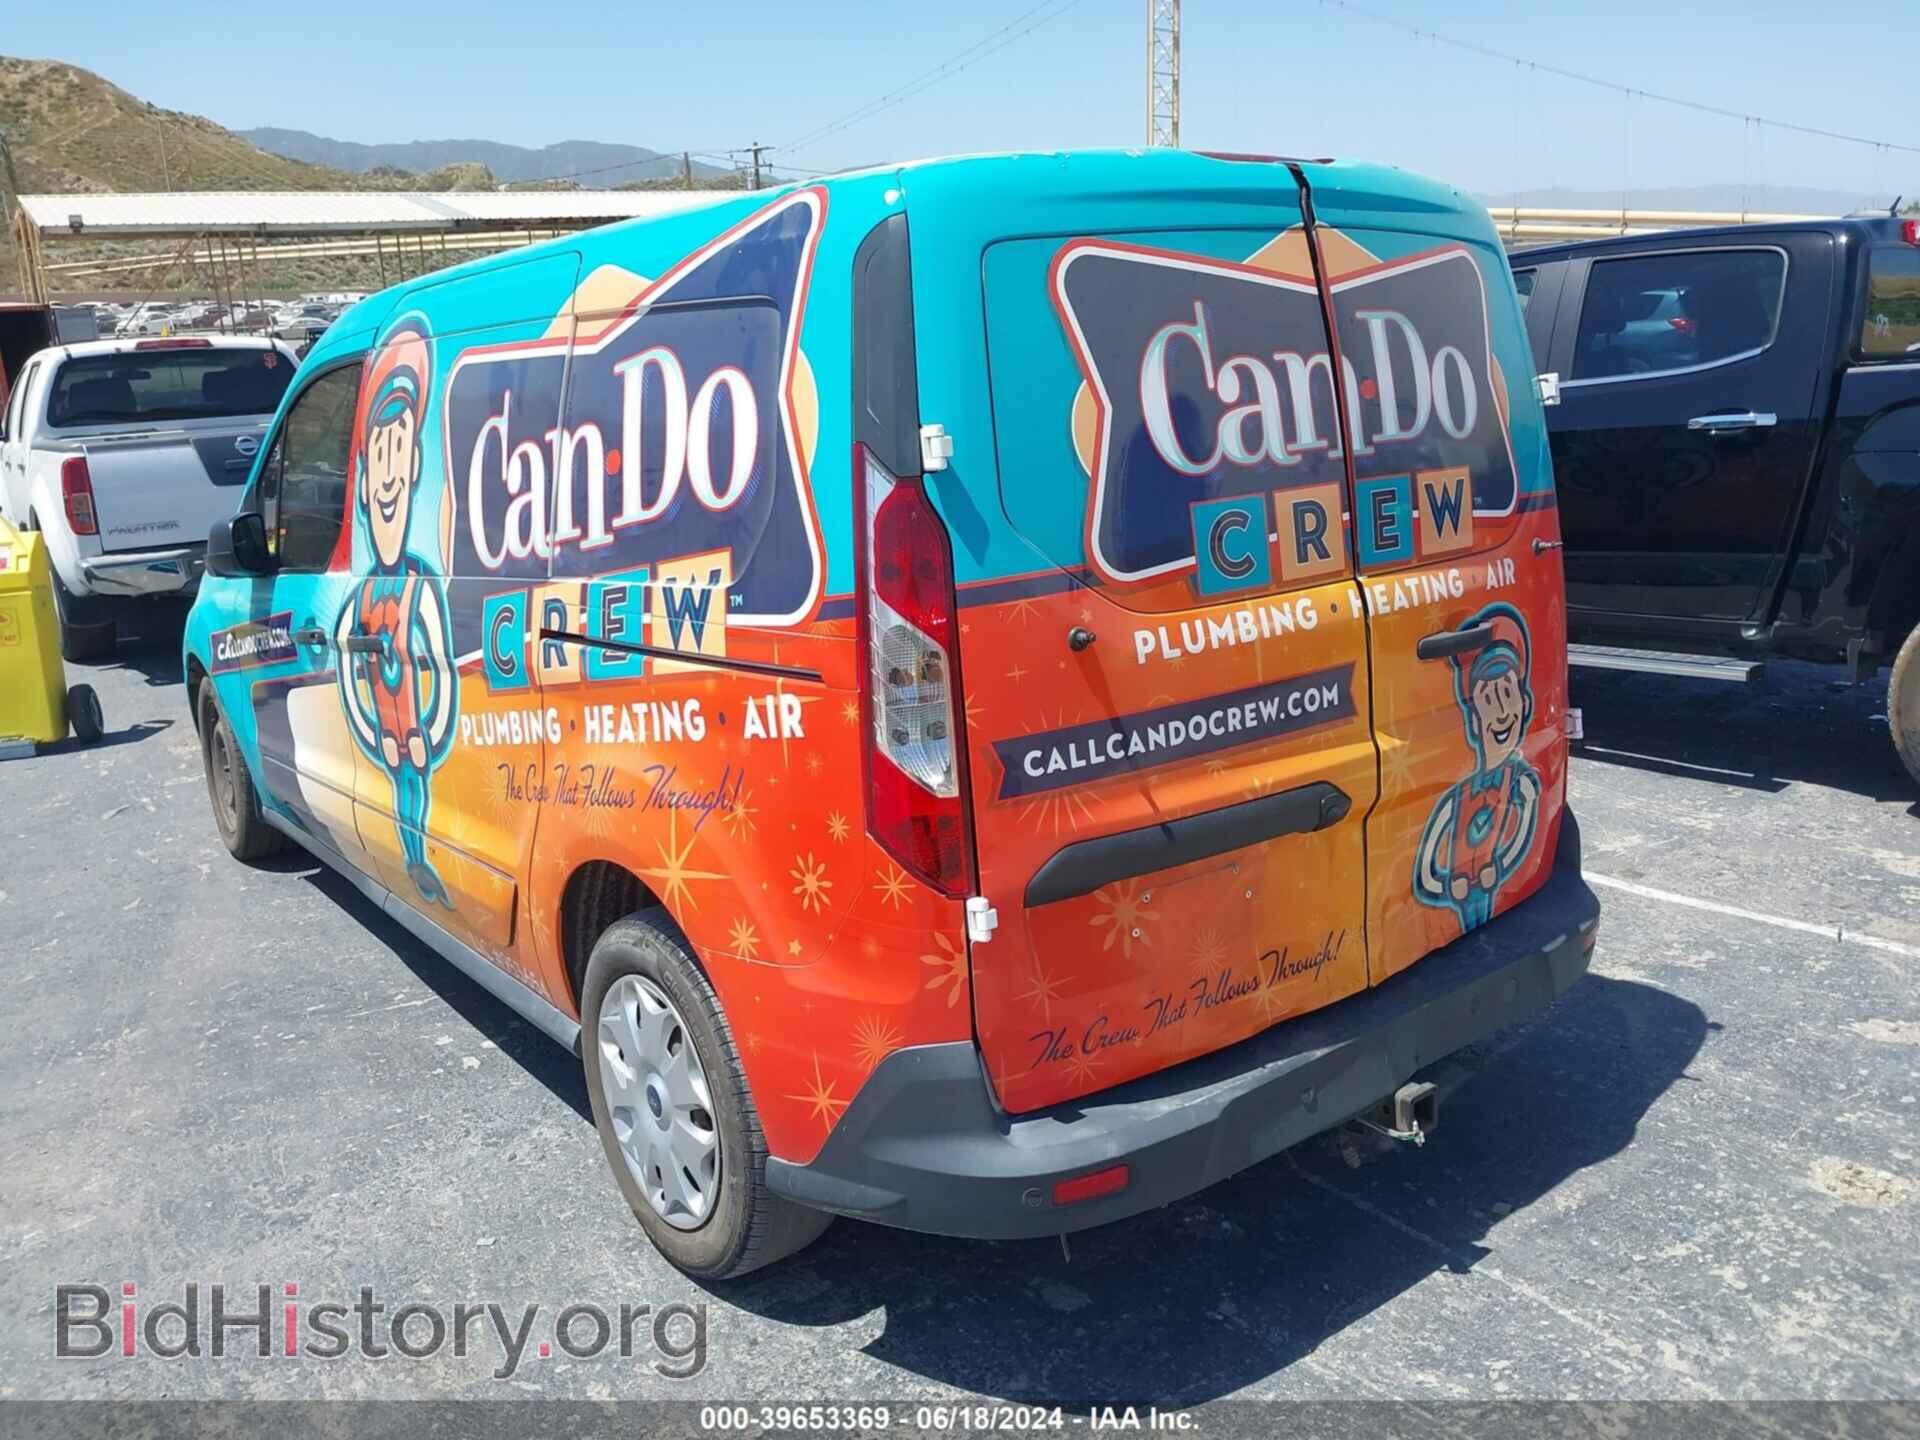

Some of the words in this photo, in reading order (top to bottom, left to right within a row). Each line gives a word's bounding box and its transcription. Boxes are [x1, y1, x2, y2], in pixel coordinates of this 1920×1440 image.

[1207, 477, 1466, 581] CREW
[490, 567, 723, 678] CREW
[1134, 599, 1318, 664] PLUMBING
[1347, 568, 1464, 622] HEATING
[1486, 557, 1516, 591] AIR
[460, 706, 562, 746] PLUMBING
[583, 698, 707, 743] HEATING
[743, 693, 804, 740] AIR
[1022, 683, 1340, 778] CALLCANDOCREW.COM
[498, 763, 522, 801] The
[554, 764, 578, 806] That
[581, 763, 637, 810] Follows
[642, 763, 744, 832] Through!
[1028, 1027, 1074, 1070] The
[1081, 1016, 1138, 1055] Crew
[1143, 994, 1187, 1038] That
[1189, 968, 1262, 1016] Follows
[1259, 929, 1346, 988] Through!
